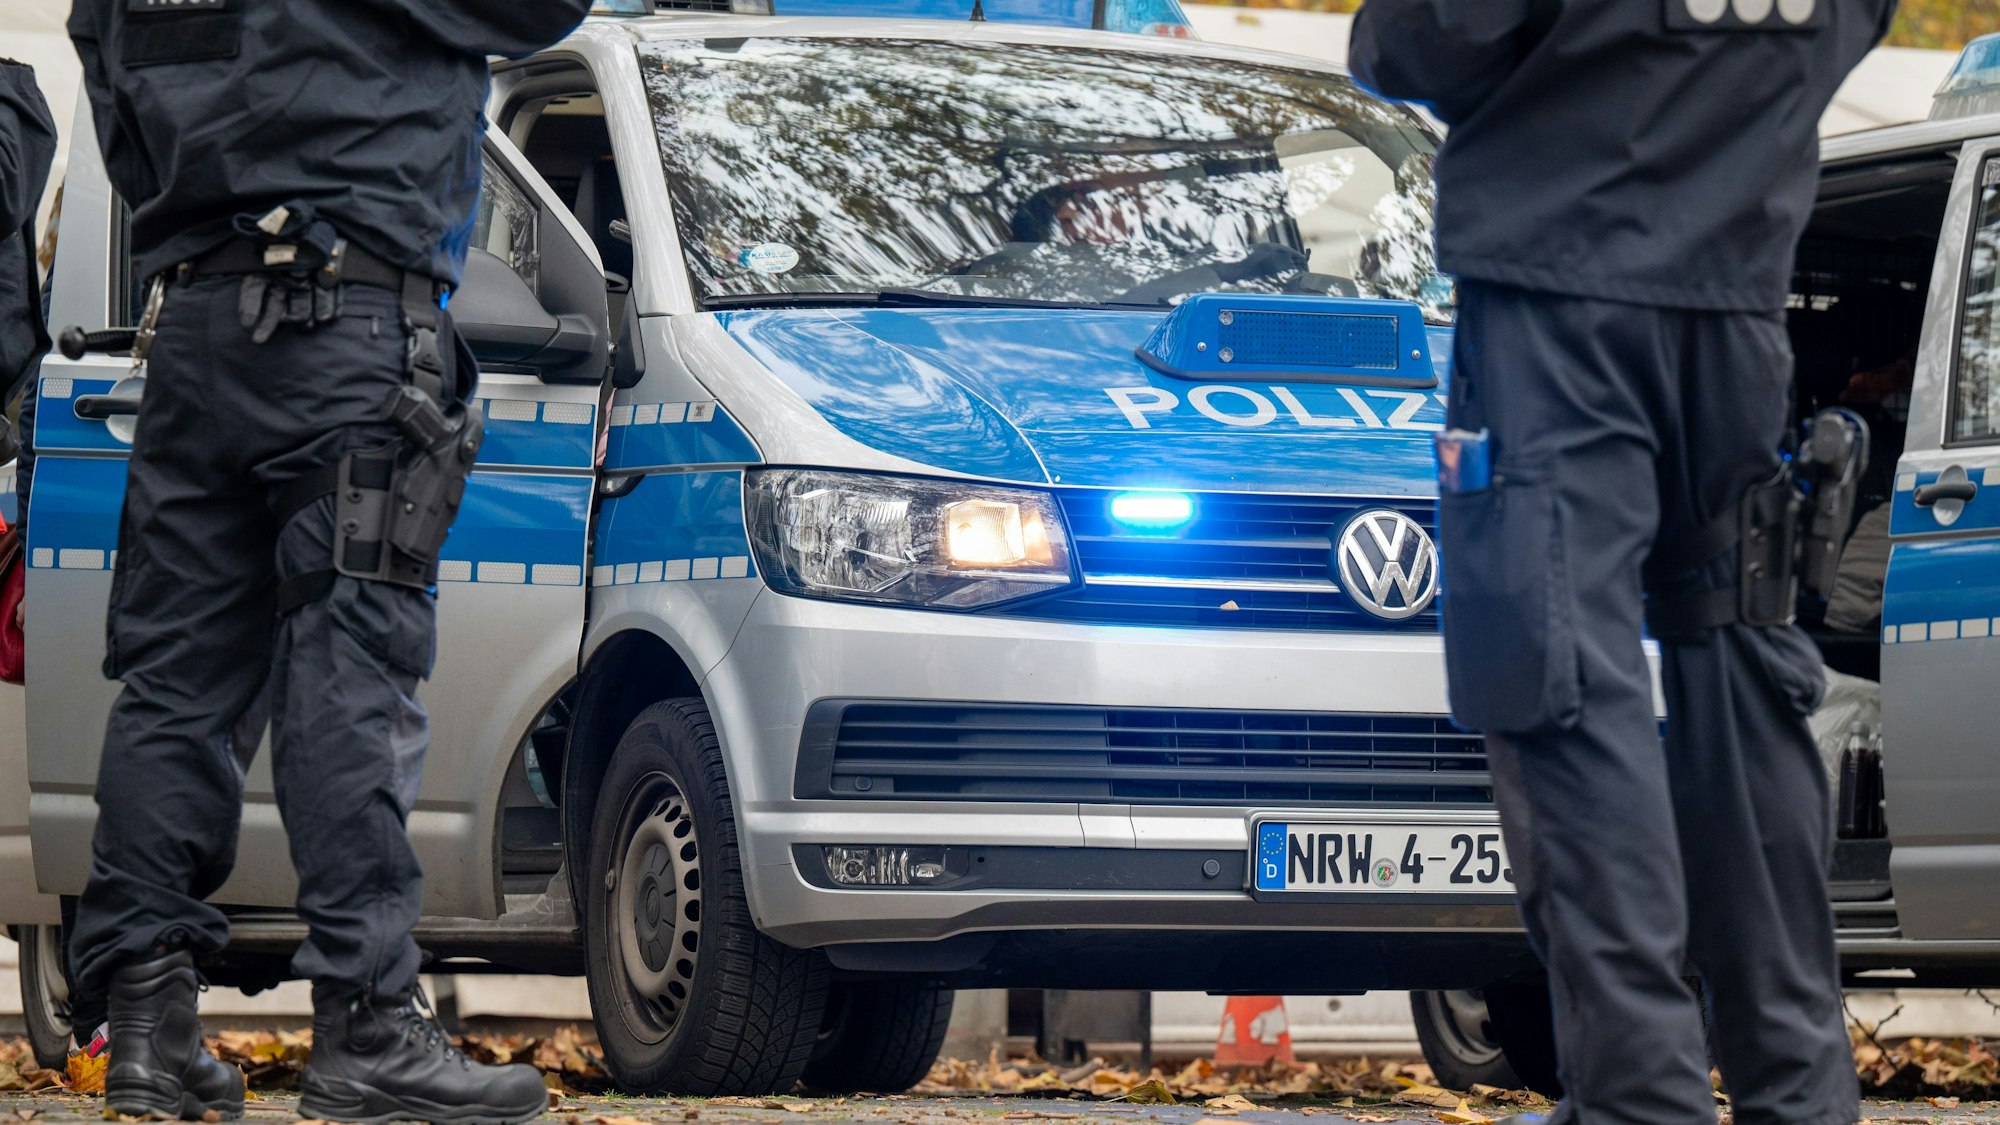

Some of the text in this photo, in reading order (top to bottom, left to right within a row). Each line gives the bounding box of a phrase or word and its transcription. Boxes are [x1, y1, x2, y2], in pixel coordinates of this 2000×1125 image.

[1103, 385, 1447, 431] POLIZ
[1341, 511, 1436, 613] VW
[1266, 864, 1277, 878] D
[1288, 832, 1373, 884] NRW
[1400, 833, 1515, 884] 4-25
